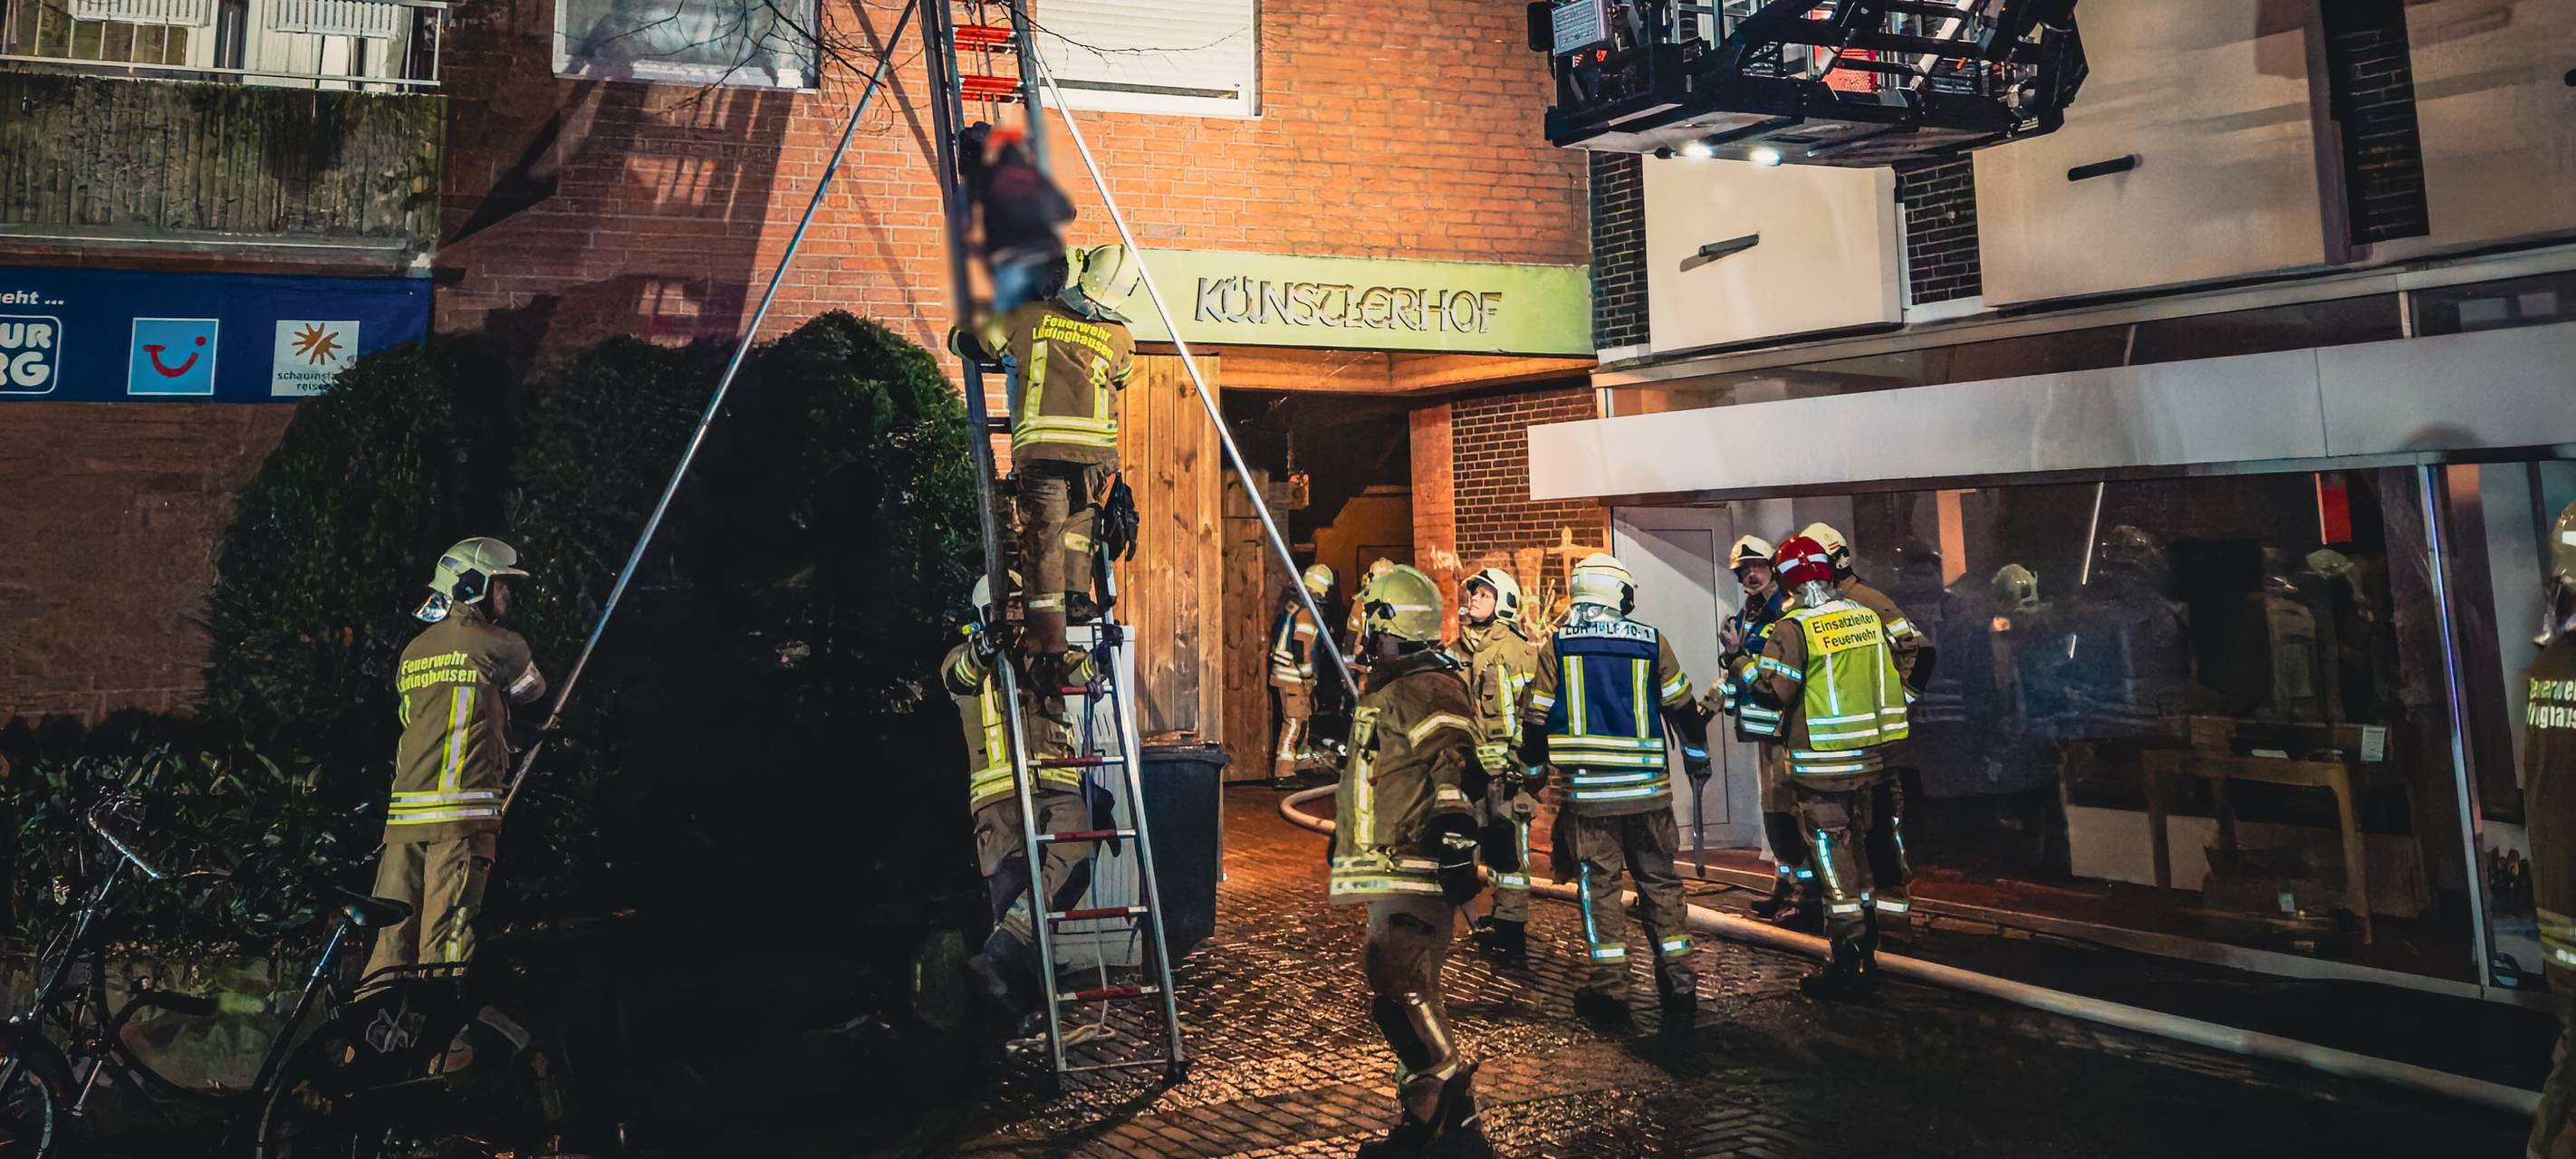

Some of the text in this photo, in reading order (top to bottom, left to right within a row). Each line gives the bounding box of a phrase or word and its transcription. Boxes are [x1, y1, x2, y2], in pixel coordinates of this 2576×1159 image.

[0, 290, 39, 305] eht
[1043, 314, 1111, 341] Feuerwehr
[1033, 325, 1114, 360] Lüdinghausen
[1812, 612, 1875, 634] Einsatzleiter
[1823, 628, 1877, 649] Feuerwehr
[401, 650, 468, 675] Feuerwehr
